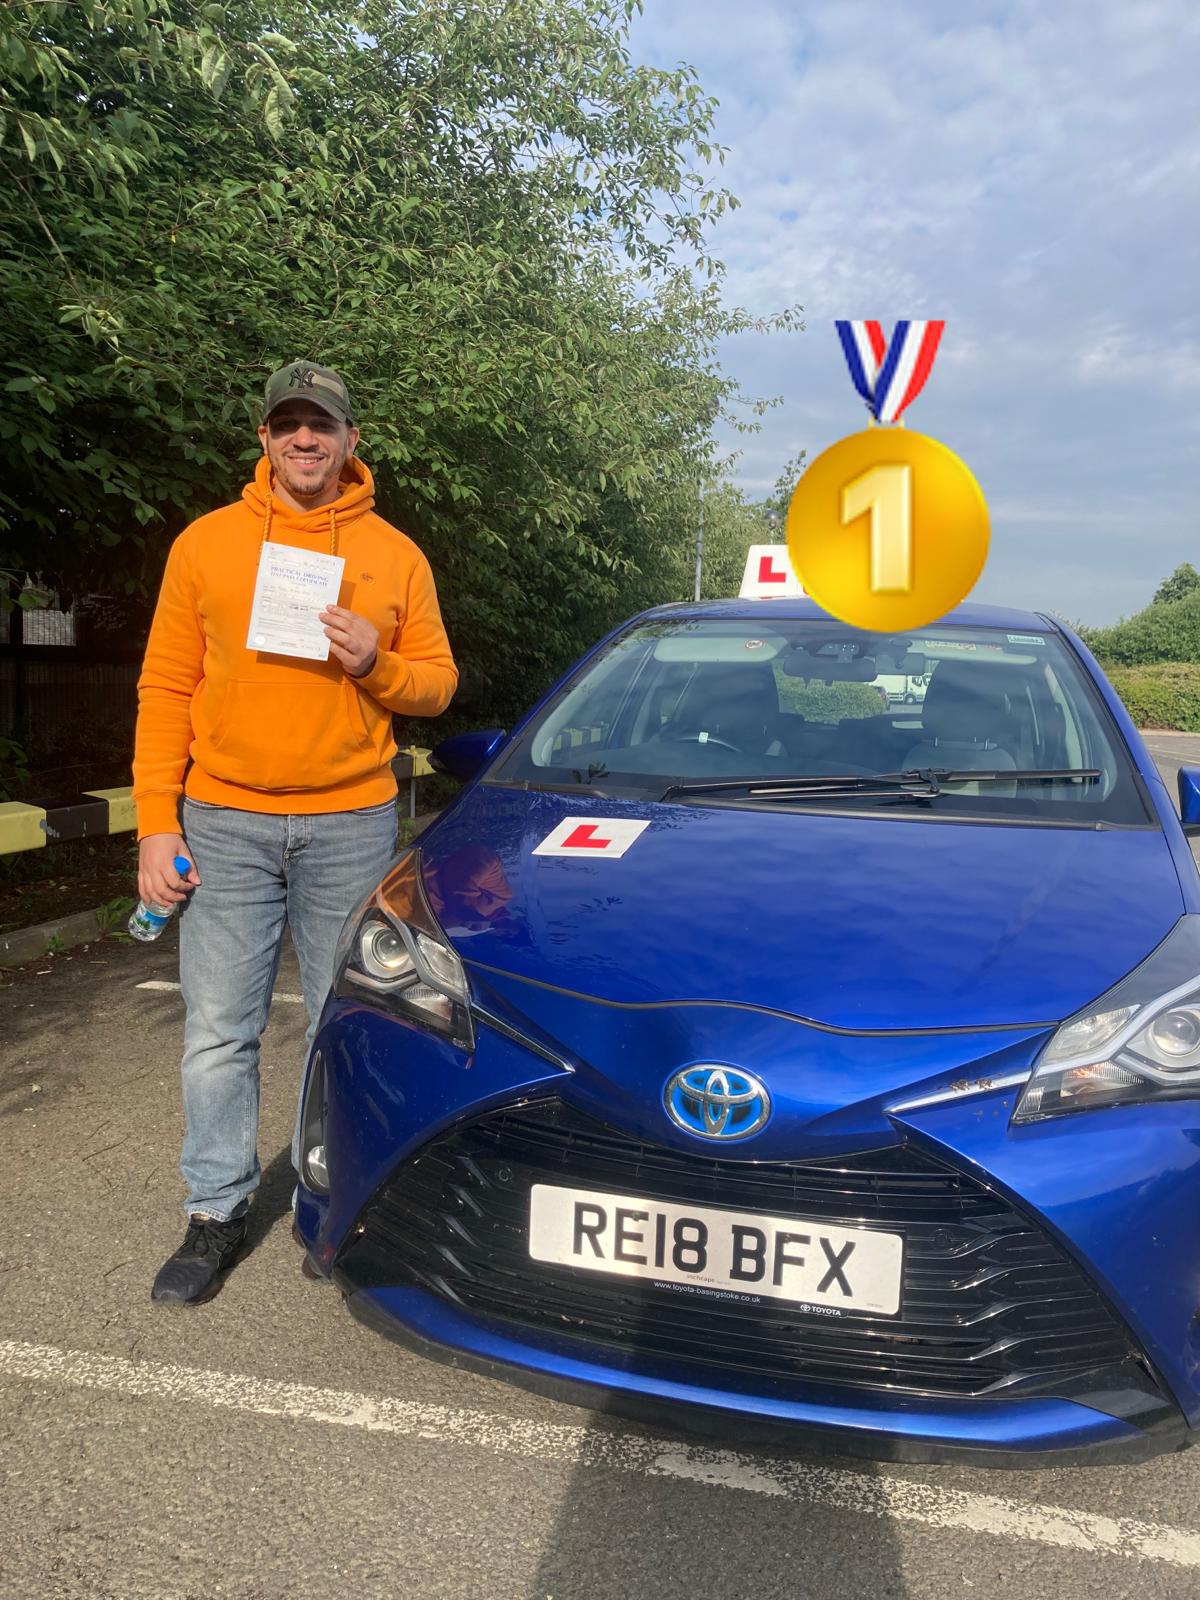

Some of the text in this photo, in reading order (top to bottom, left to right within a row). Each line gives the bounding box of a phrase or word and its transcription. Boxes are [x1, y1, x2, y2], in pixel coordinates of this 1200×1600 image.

[271, 566, 329, 583] PRACTICAL DRIVING
[758, 556, 787, 583] L
[560, 824, 612, 849] L
[573, 1201, 856, 1297] RE18 BFX
[653, 1280, 761, 1304] www.toyota-basingstoke.co.uk
[811, 1305, 842, 1316] TOYOTA
